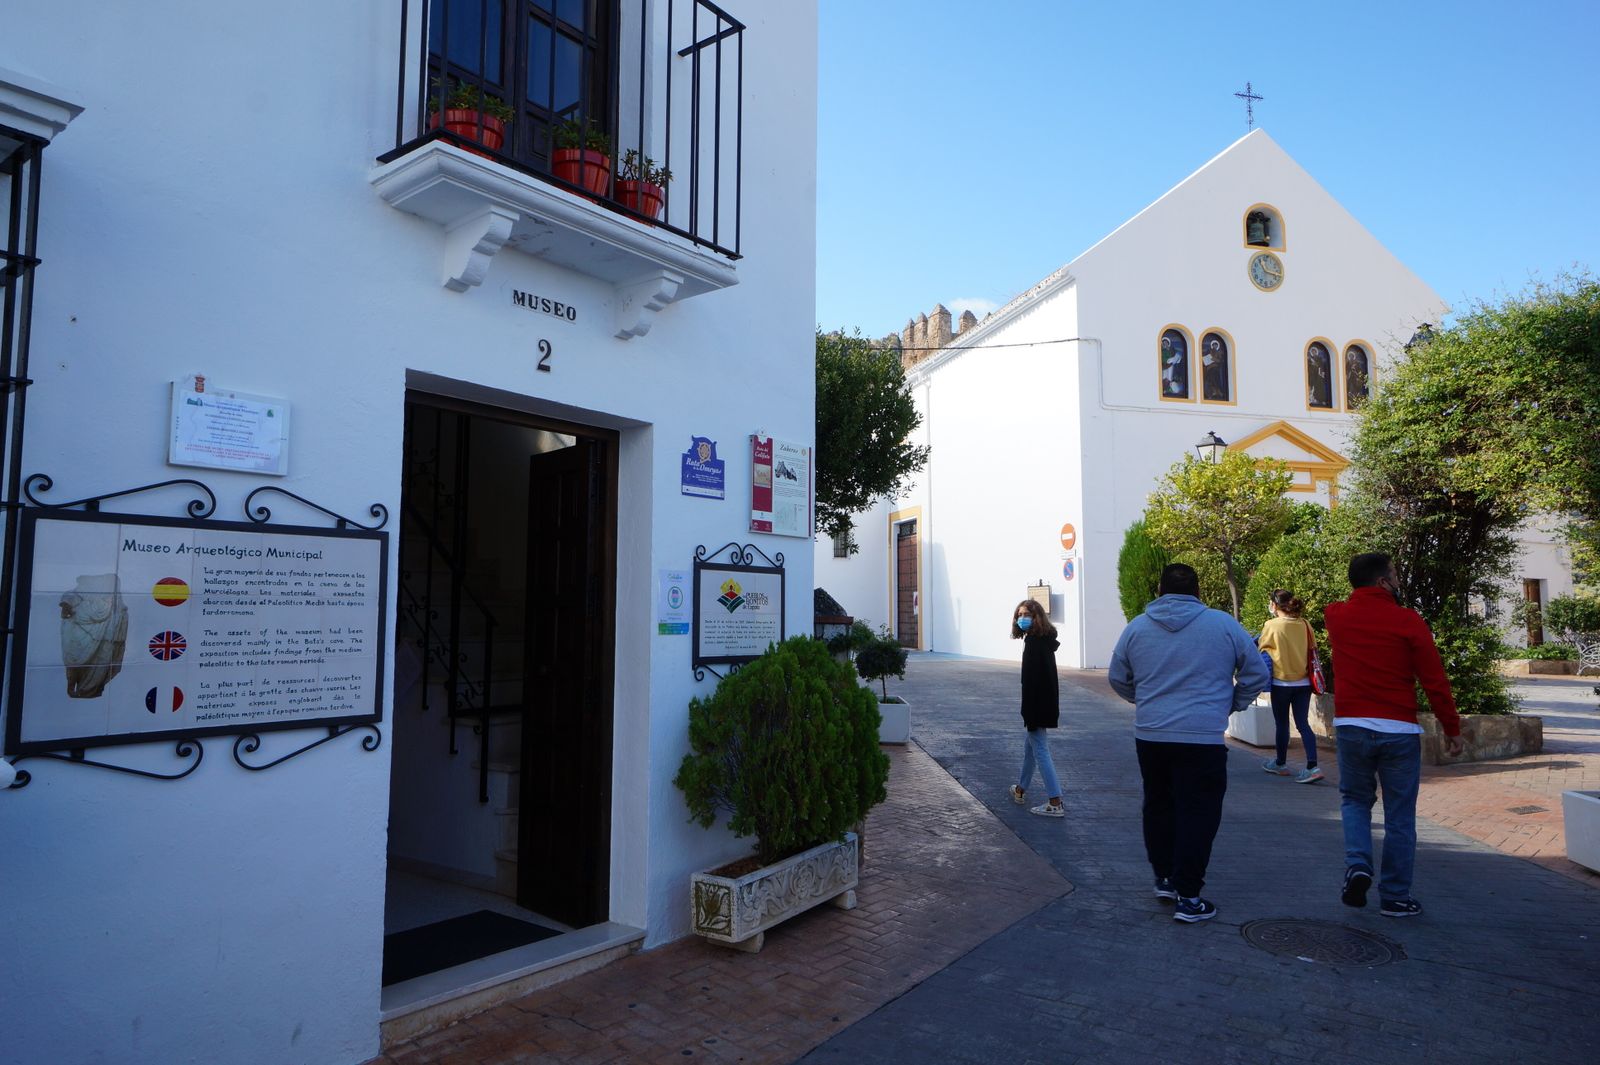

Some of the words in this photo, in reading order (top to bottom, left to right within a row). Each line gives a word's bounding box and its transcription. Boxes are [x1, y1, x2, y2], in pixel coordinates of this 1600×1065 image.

[513, 289, 576, 321] MUSEO
[537, 339, 552, 372] 2
[122, 539, 170, 553] Museo
[176, 543, 262, 559] Arqueológico
[266, 547, 323, 561] Municipal
[204, 578, 238, 586] hallazgos
[237, 680, 253, 688] part
[197, 691, 237, 701] appartient
[259, 688, 282, 697] grotte
